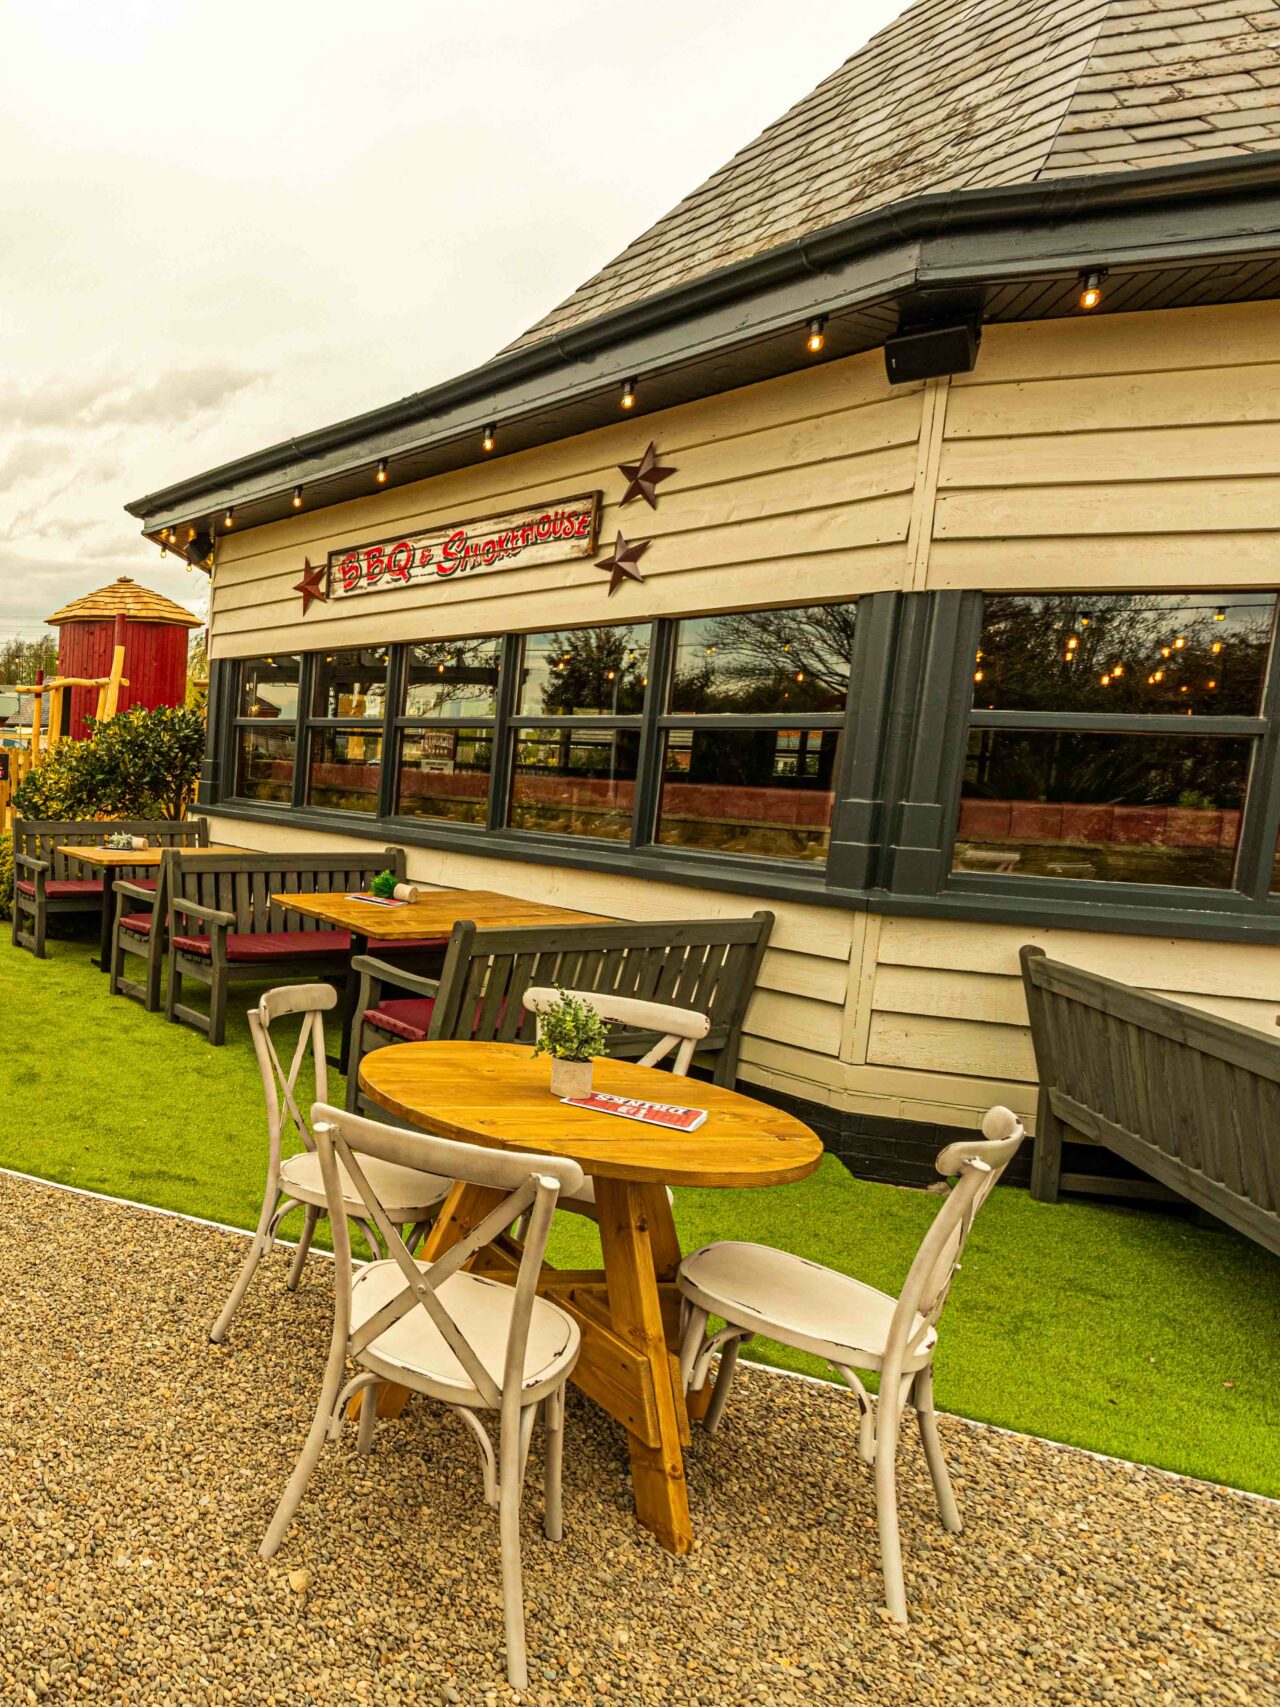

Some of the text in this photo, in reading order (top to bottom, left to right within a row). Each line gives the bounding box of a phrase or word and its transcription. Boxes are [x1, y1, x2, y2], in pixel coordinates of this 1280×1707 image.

[339, 510, 592, 593] BBQ & SMOKEHOUSE
[595, 1093, 690, 1116] DRINKS
